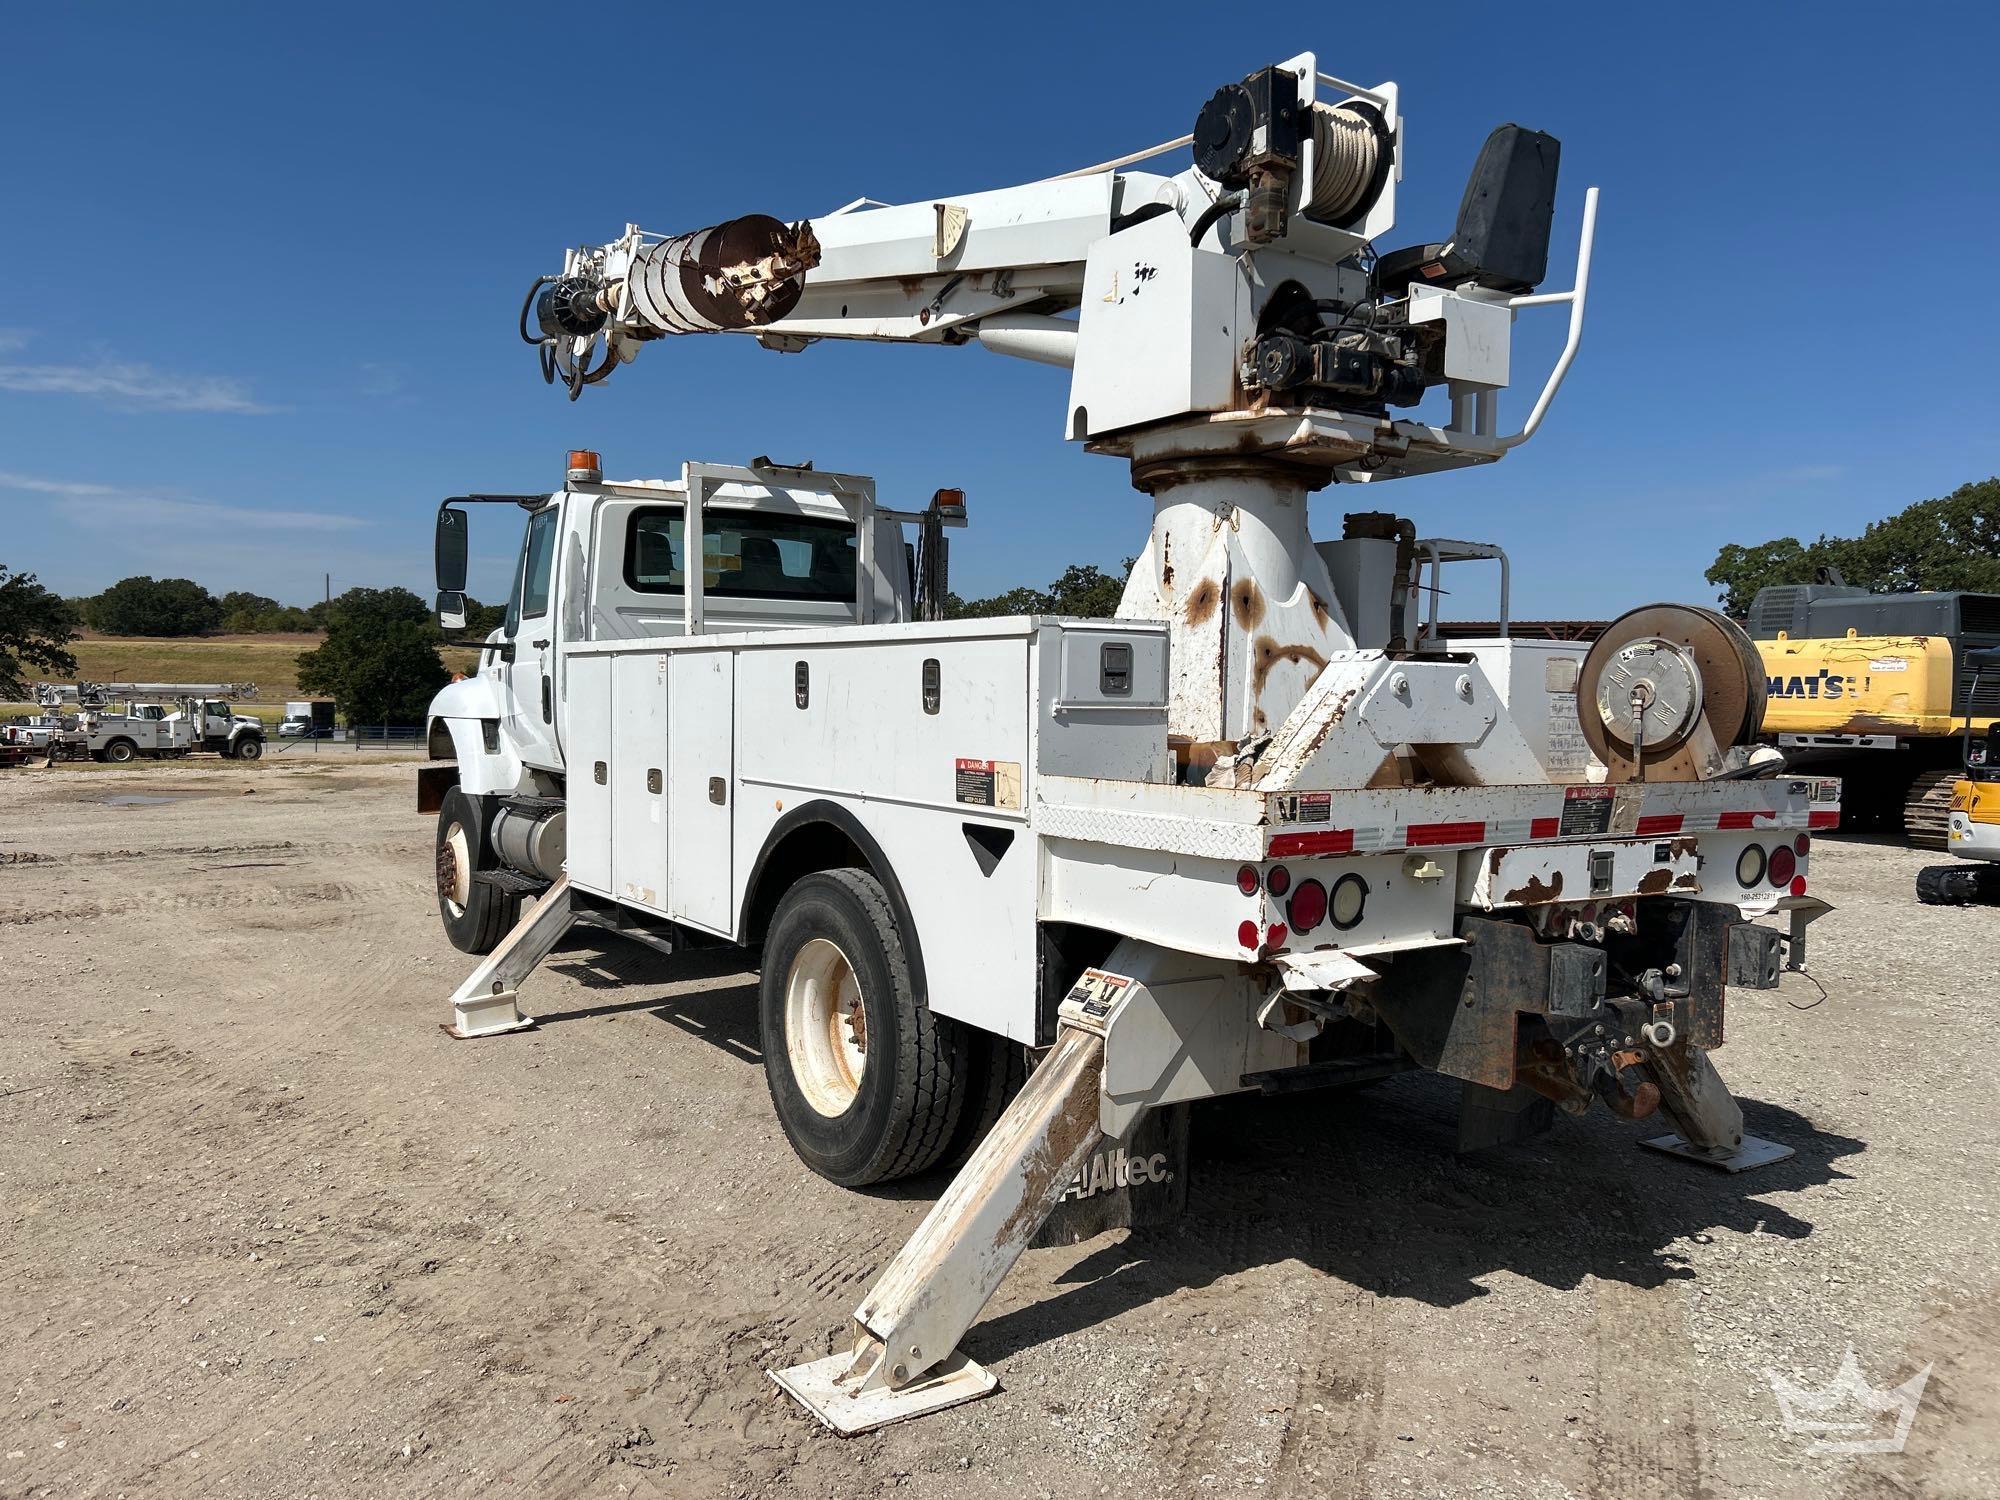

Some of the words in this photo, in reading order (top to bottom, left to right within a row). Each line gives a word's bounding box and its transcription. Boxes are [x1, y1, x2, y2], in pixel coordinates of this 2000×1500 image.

[967, 760, 990, 770] DANGER
[1580, 787, 1609, 800] DANGER
[1583, 826, 1599, 834] CLEAR
